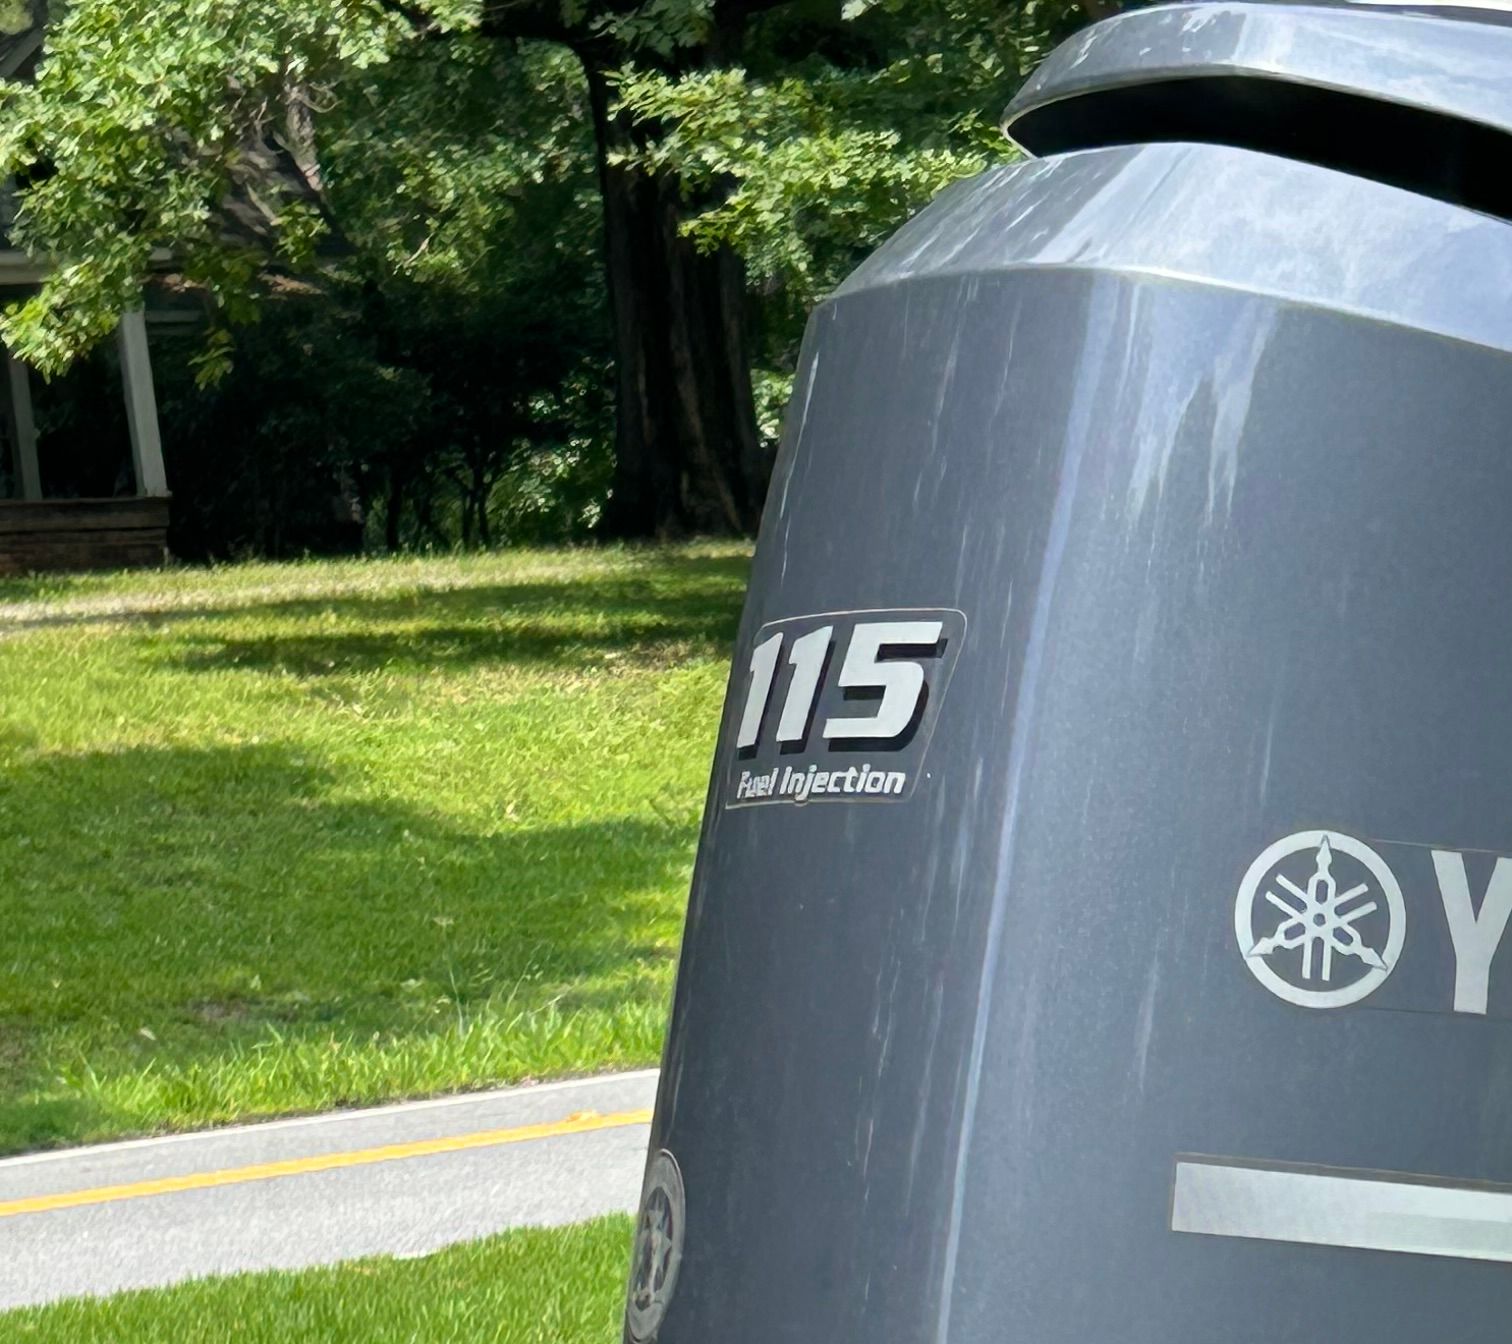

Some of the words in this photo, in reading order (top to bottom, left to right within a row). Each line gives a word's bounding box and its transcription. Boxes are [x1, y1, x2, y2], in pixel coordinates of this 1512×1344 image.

[736, 620, 946, 755] 115
[736, 767, 779, 799] Fuel
[779, 763, 906, 800] Injection
